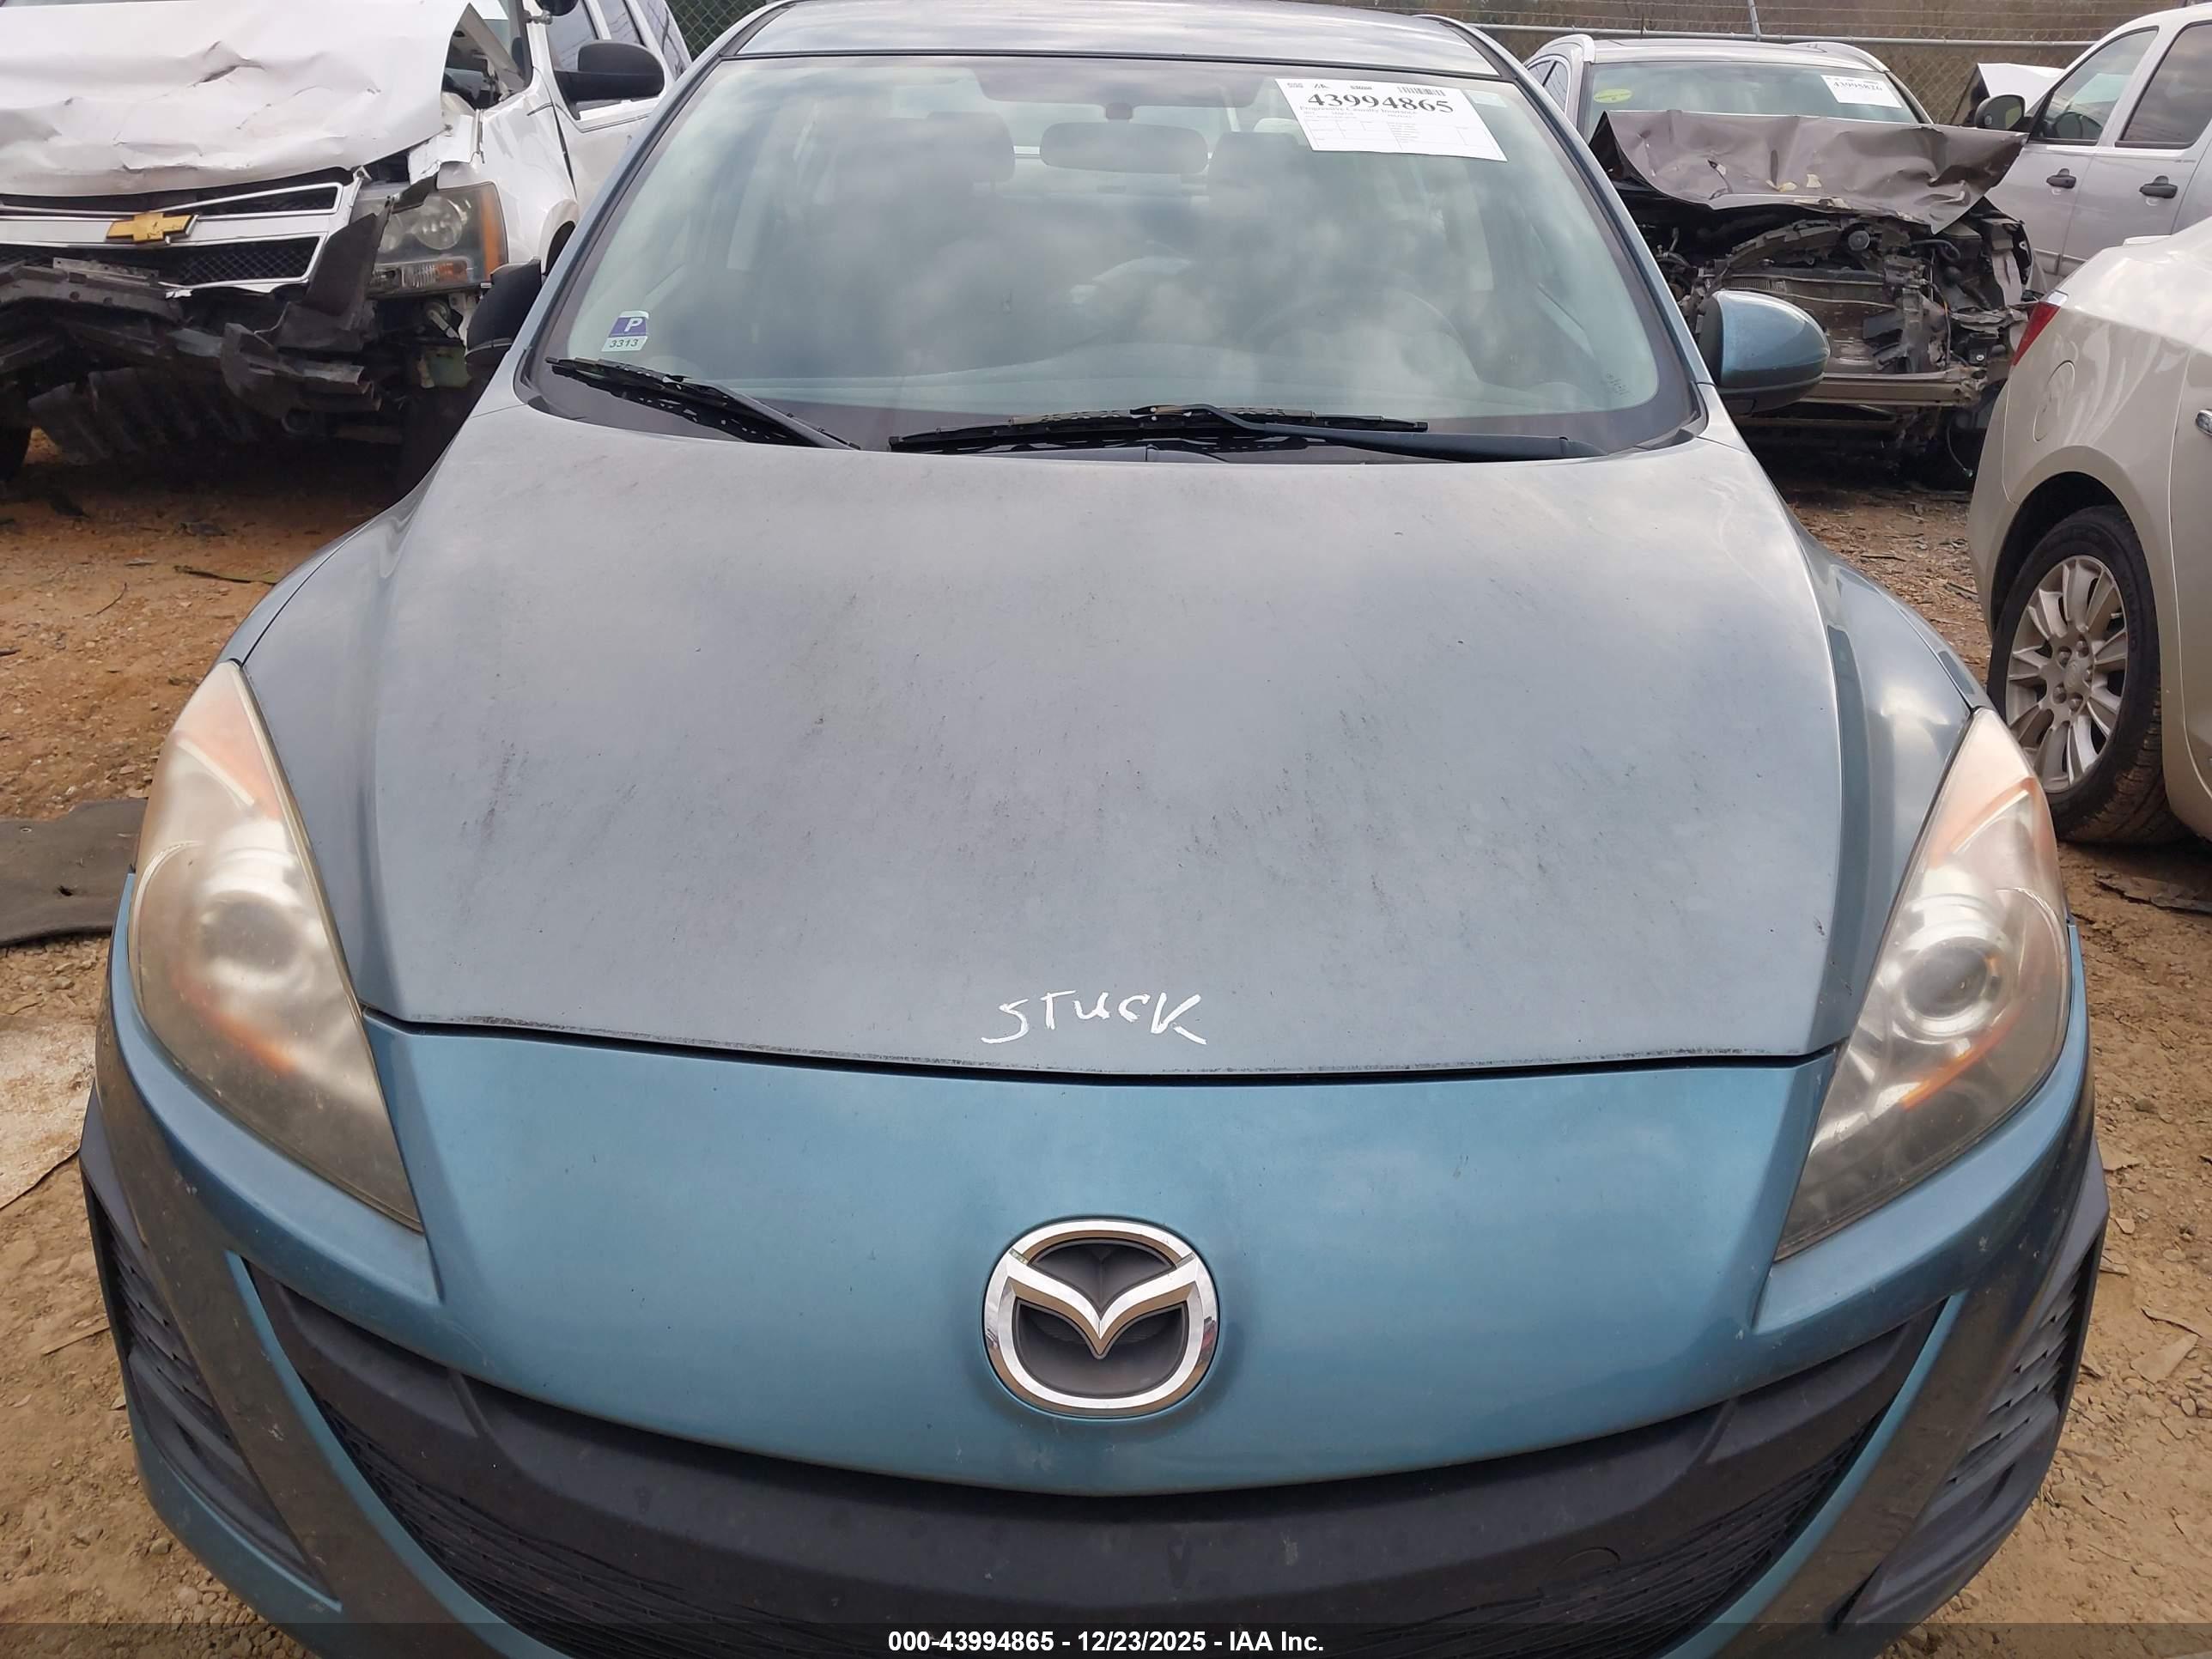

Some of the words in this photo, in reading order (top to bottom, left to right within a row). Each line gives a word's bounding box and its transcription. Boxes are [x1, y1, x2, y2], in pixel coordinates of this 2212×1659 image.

[1308, 94, 1454, 113] 43994865
[624, 318, 642, 332] P
[610, 339, 638, 348] 3313
